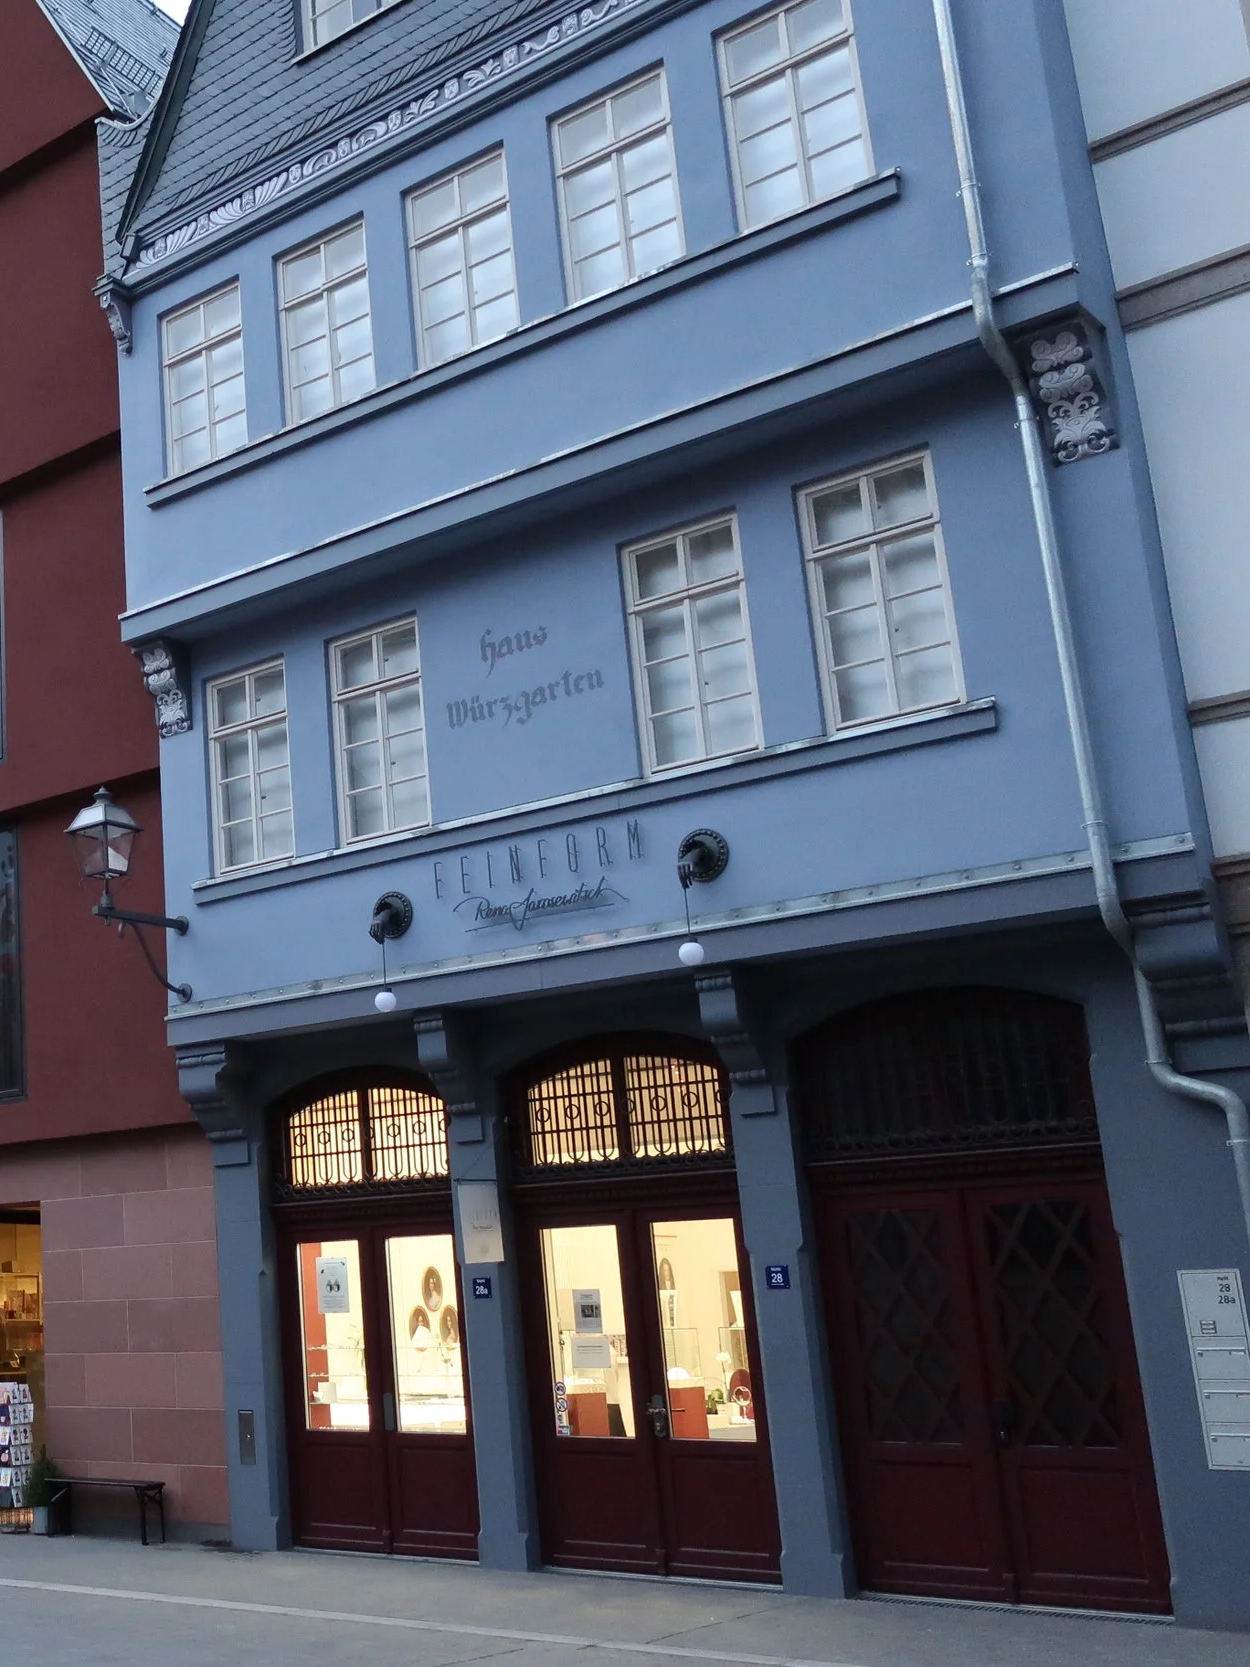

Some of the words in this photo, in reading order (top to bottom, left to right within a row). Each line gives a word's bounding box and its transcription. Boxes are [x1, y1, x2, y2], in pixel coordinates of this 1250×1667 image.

[446, 669, 605, 729] Würzgarten
[434, 819, 643, 899] FEINFORM
[771, 1273, 783, 1283] 28
[475, 1285, 488, 1295] 28a
[1218, 1283, 1231, 1292] 28
[1218, 1295, 1236, 1304] 28a
